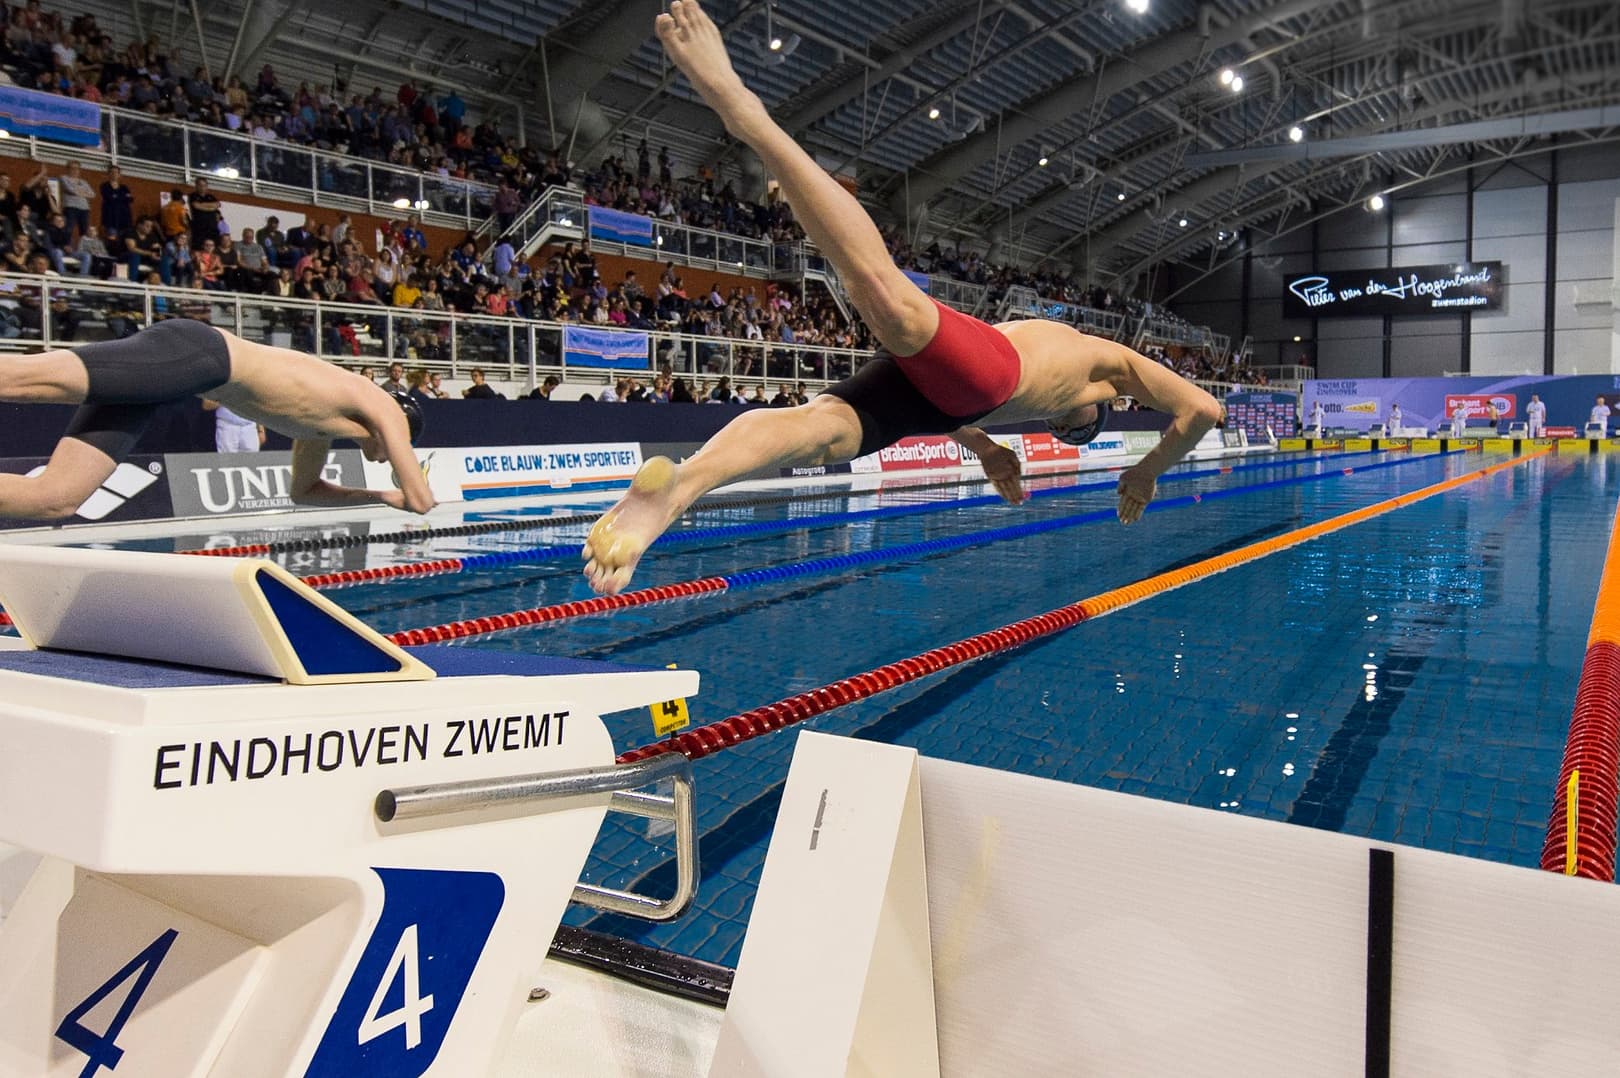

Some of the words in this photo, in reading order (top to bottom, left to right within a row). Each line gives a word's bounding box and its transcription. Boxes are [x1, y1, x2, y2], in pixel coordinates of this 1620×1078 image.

[1340, 289, 1362, 300] van
[1366, 279, 1388, 295] den
[190, 452, 343, 514] UNIÉ
[549, 452, 581, 469] ZWEM
[585, 450, 636, 468] SPORTIEF!
[662, 699, 680, 717] 4
[153, 723, 429, 790] EINDHOVEN
[443, 711, 570, 758] ZWEMT
[54, 928, 180, 1078] 4
[358, 923, 434, 1051] 4
